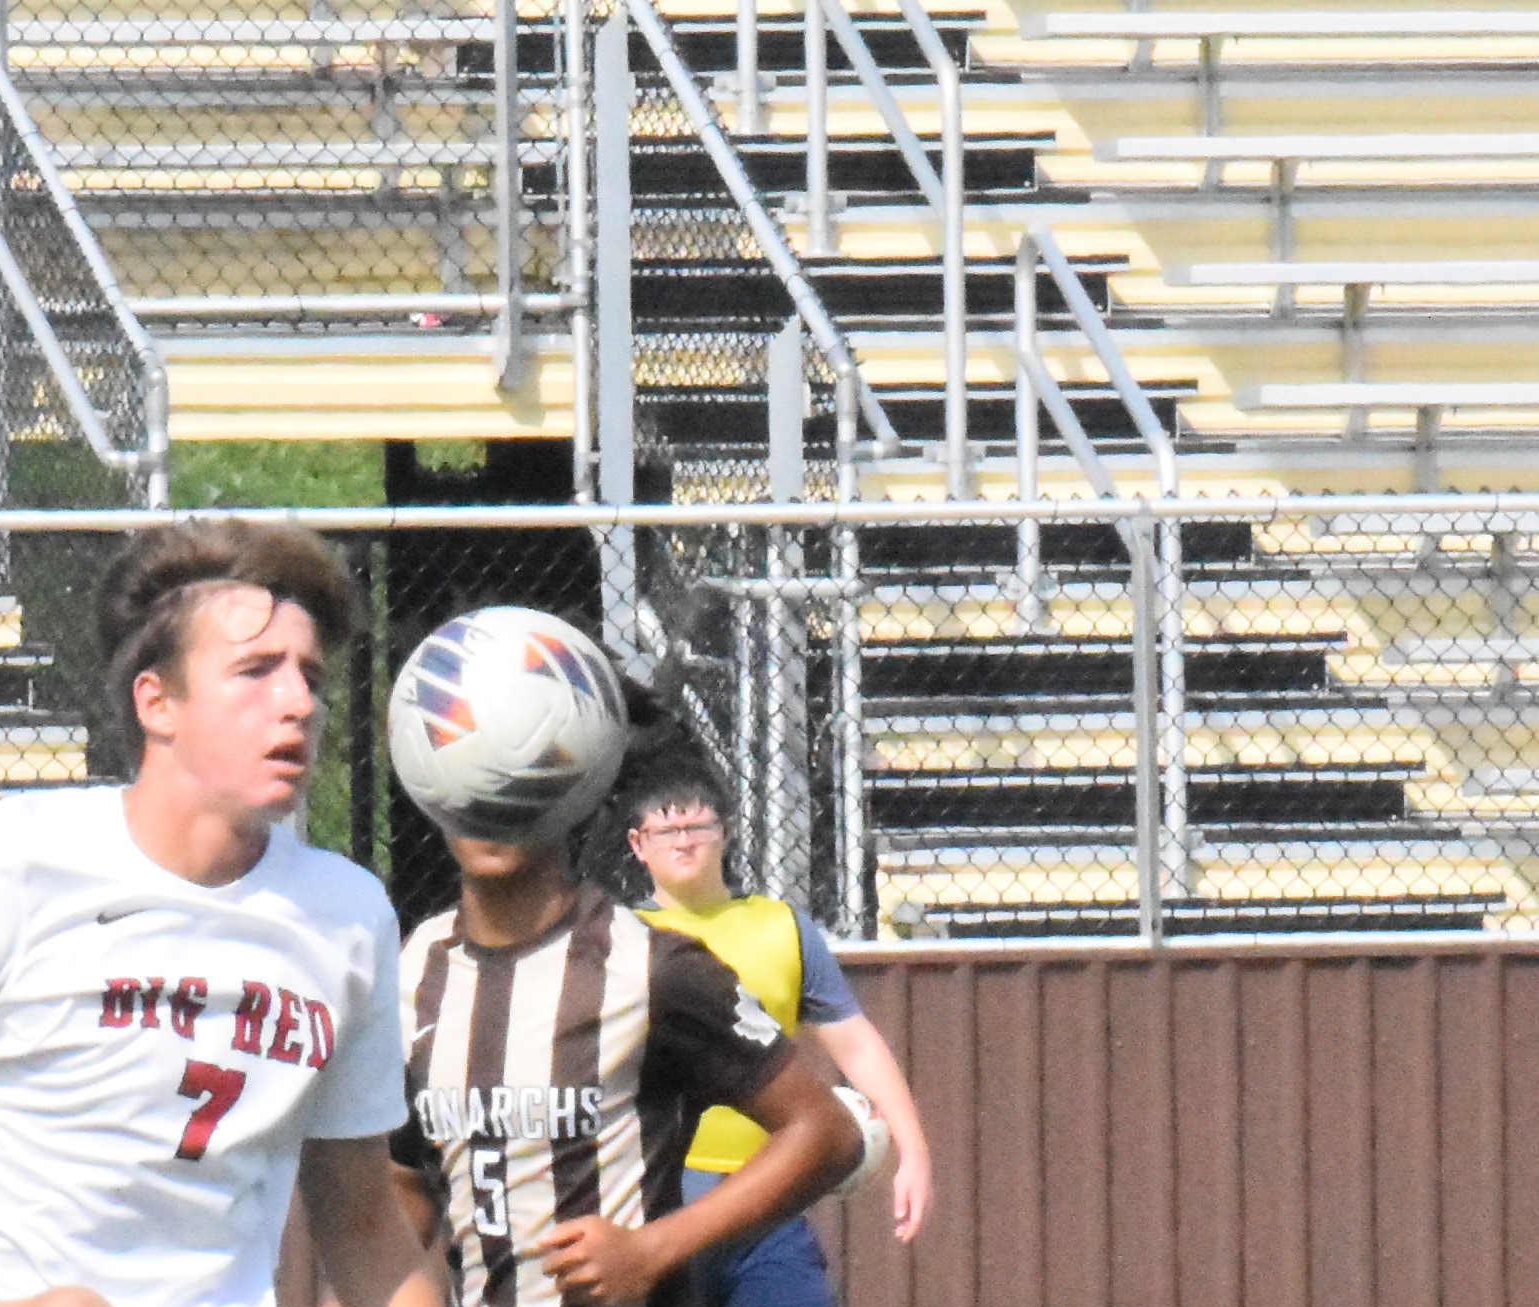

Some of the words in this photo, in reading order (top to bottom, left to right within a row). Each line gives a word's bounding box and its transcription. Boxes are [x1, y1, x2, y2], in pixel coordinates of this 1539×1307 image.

[230, 979, 336, 1070] RED
[174, 1057, 248, 1162] 7
[472, 1149, 508, 1237] 5
